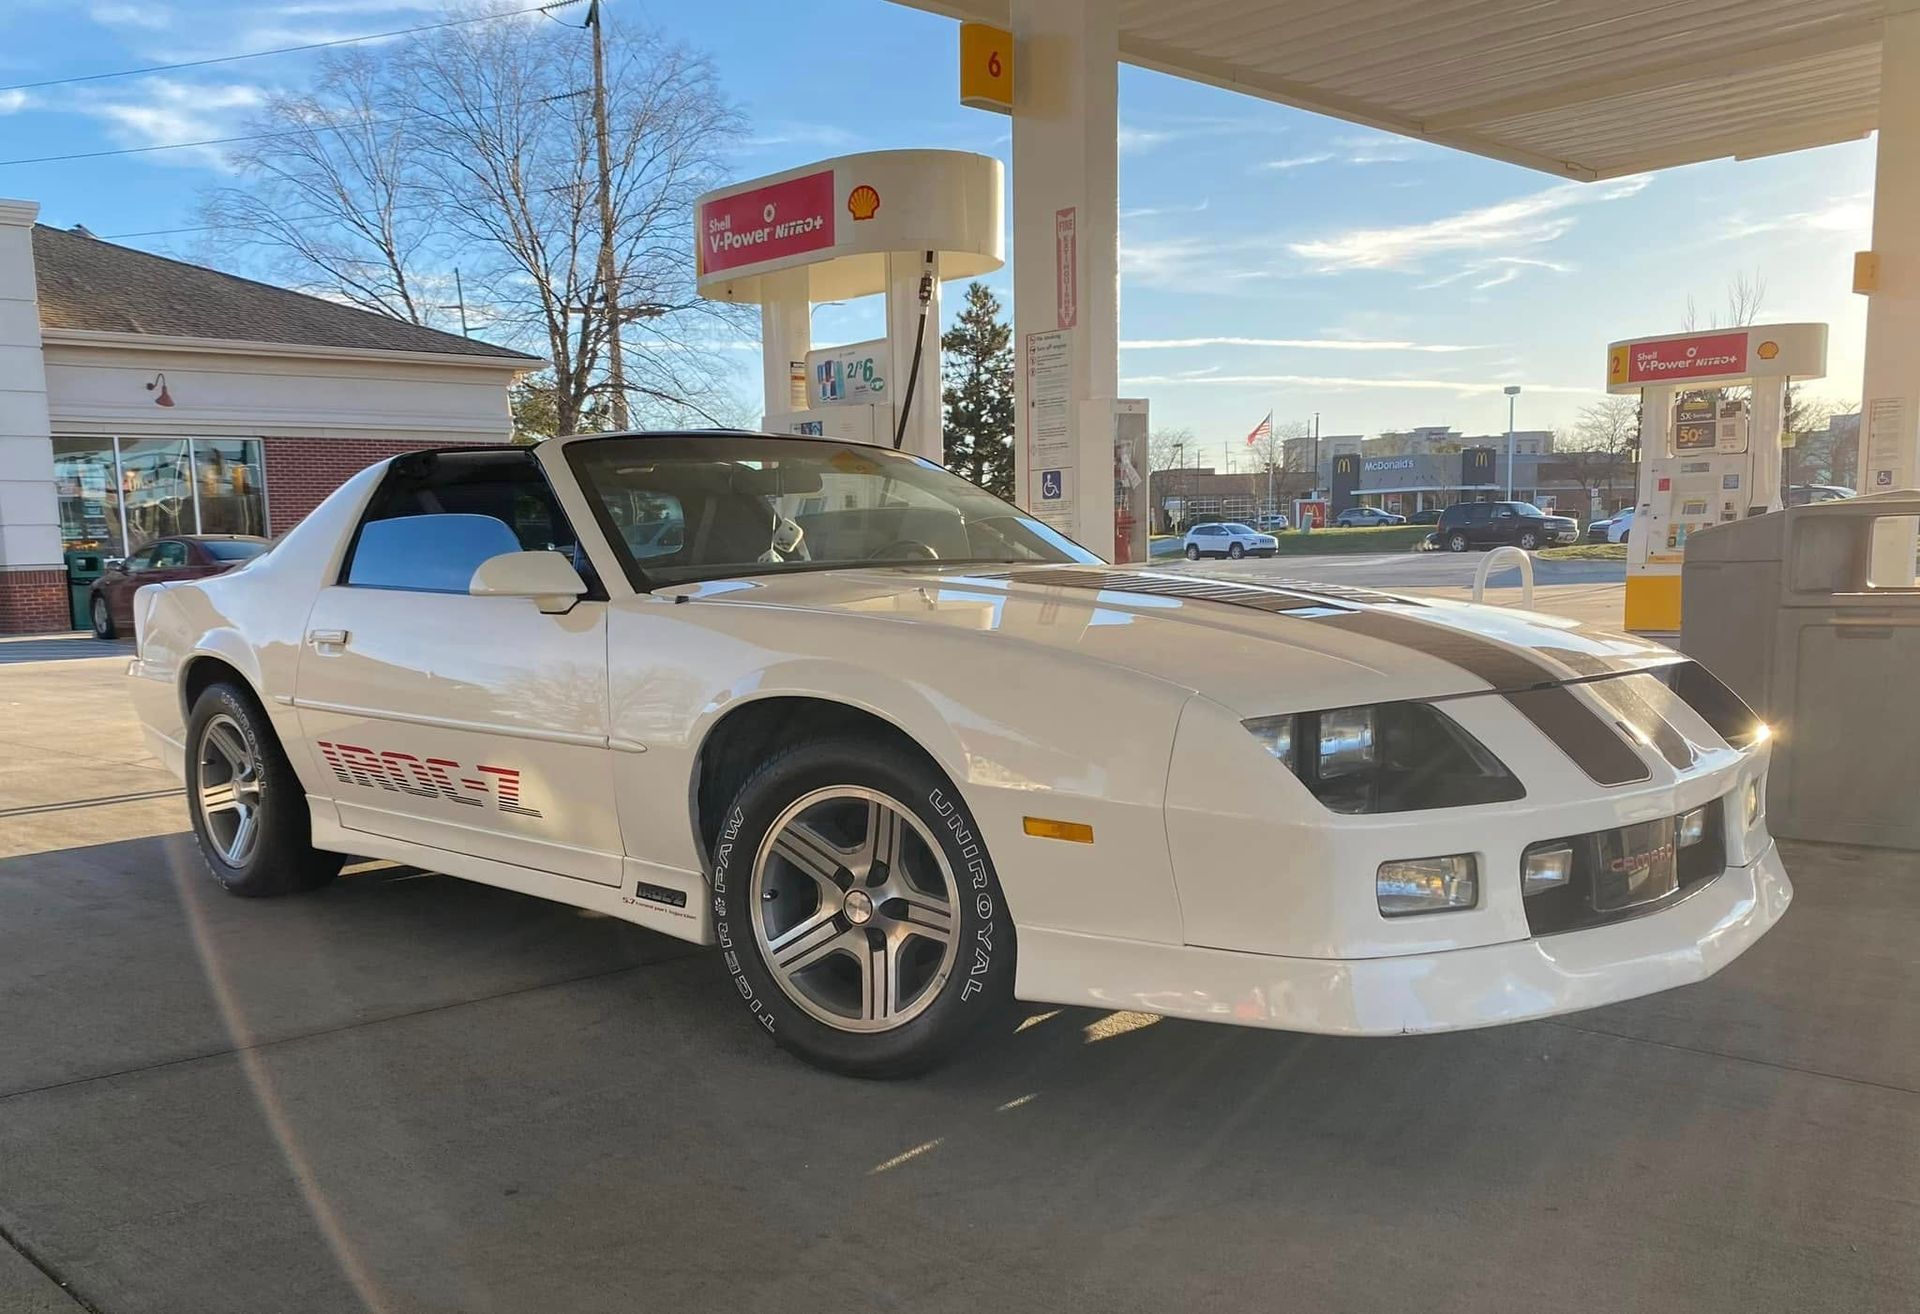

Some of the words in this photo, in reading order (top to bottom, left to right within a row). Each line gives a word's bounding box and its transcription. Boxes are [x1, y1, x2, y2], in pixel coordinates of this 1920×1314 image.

[988, 51, 1002, 78] 6
[709, 214, 731, 234] Shell
[1059, 219, 1073, 233] FIRE
[710, 228, 770, 254] V-Power
[1612, 355, 1621, 375] 2
[1637, 352, 1658, 361] Shell
[1637, 359, 1692, 373] V-Power
[1364, 459, 1414, 472] McDonald's
[714, 806, 745, 894] PAW
[928, 788, 993, 1002] UNIROYAL
[717, 921, 776, 1034] TIGER
